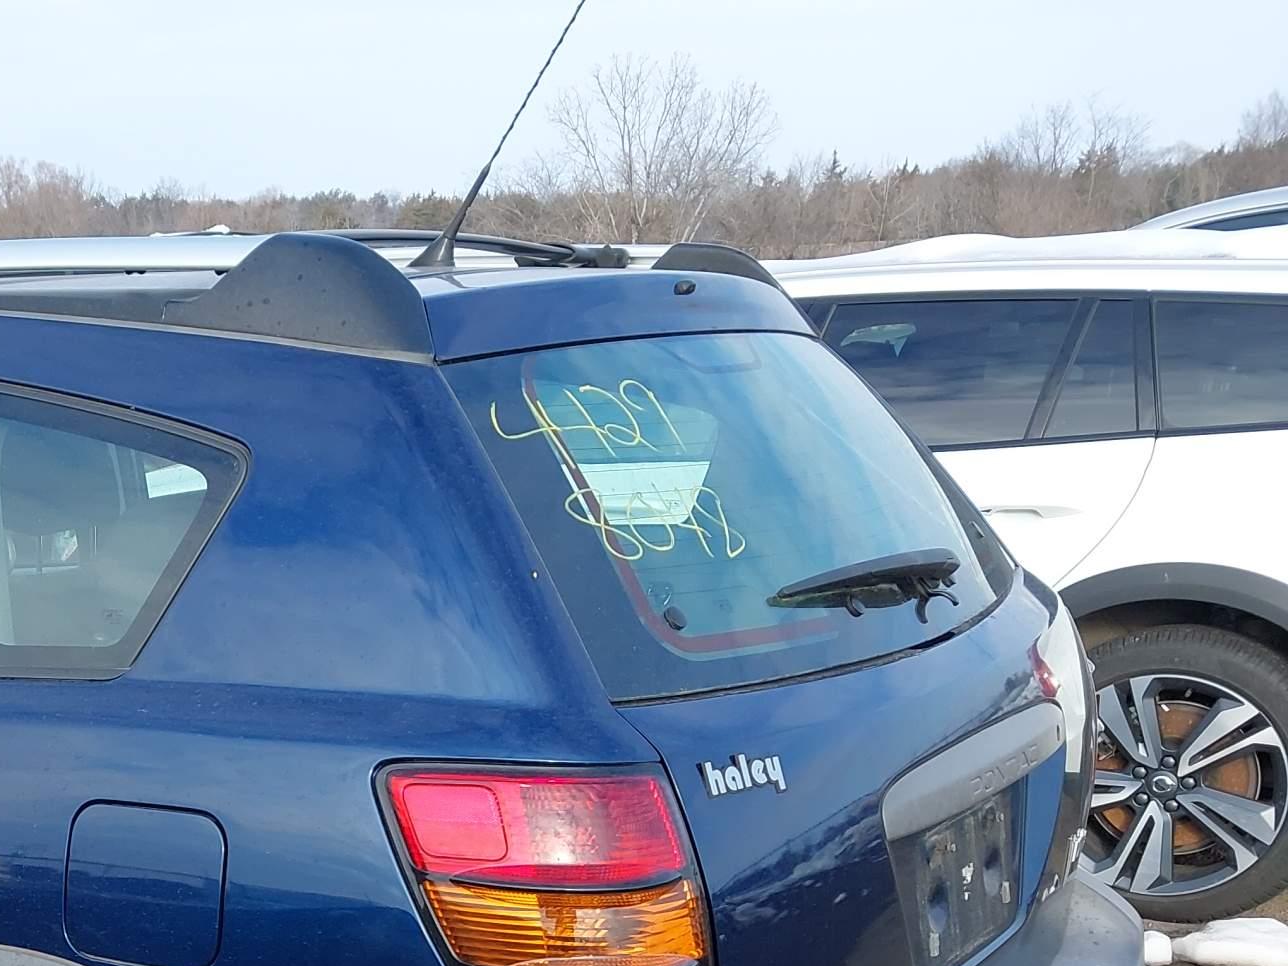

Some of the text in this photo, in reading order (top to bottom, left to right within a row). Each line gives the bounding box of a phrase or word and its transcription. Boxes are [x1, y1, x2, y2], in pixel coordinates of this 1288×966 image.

[490, 379, 687, 469] 4429
[565, 485, 746, 561] 8048
[704, 753, 787, 796] haley
